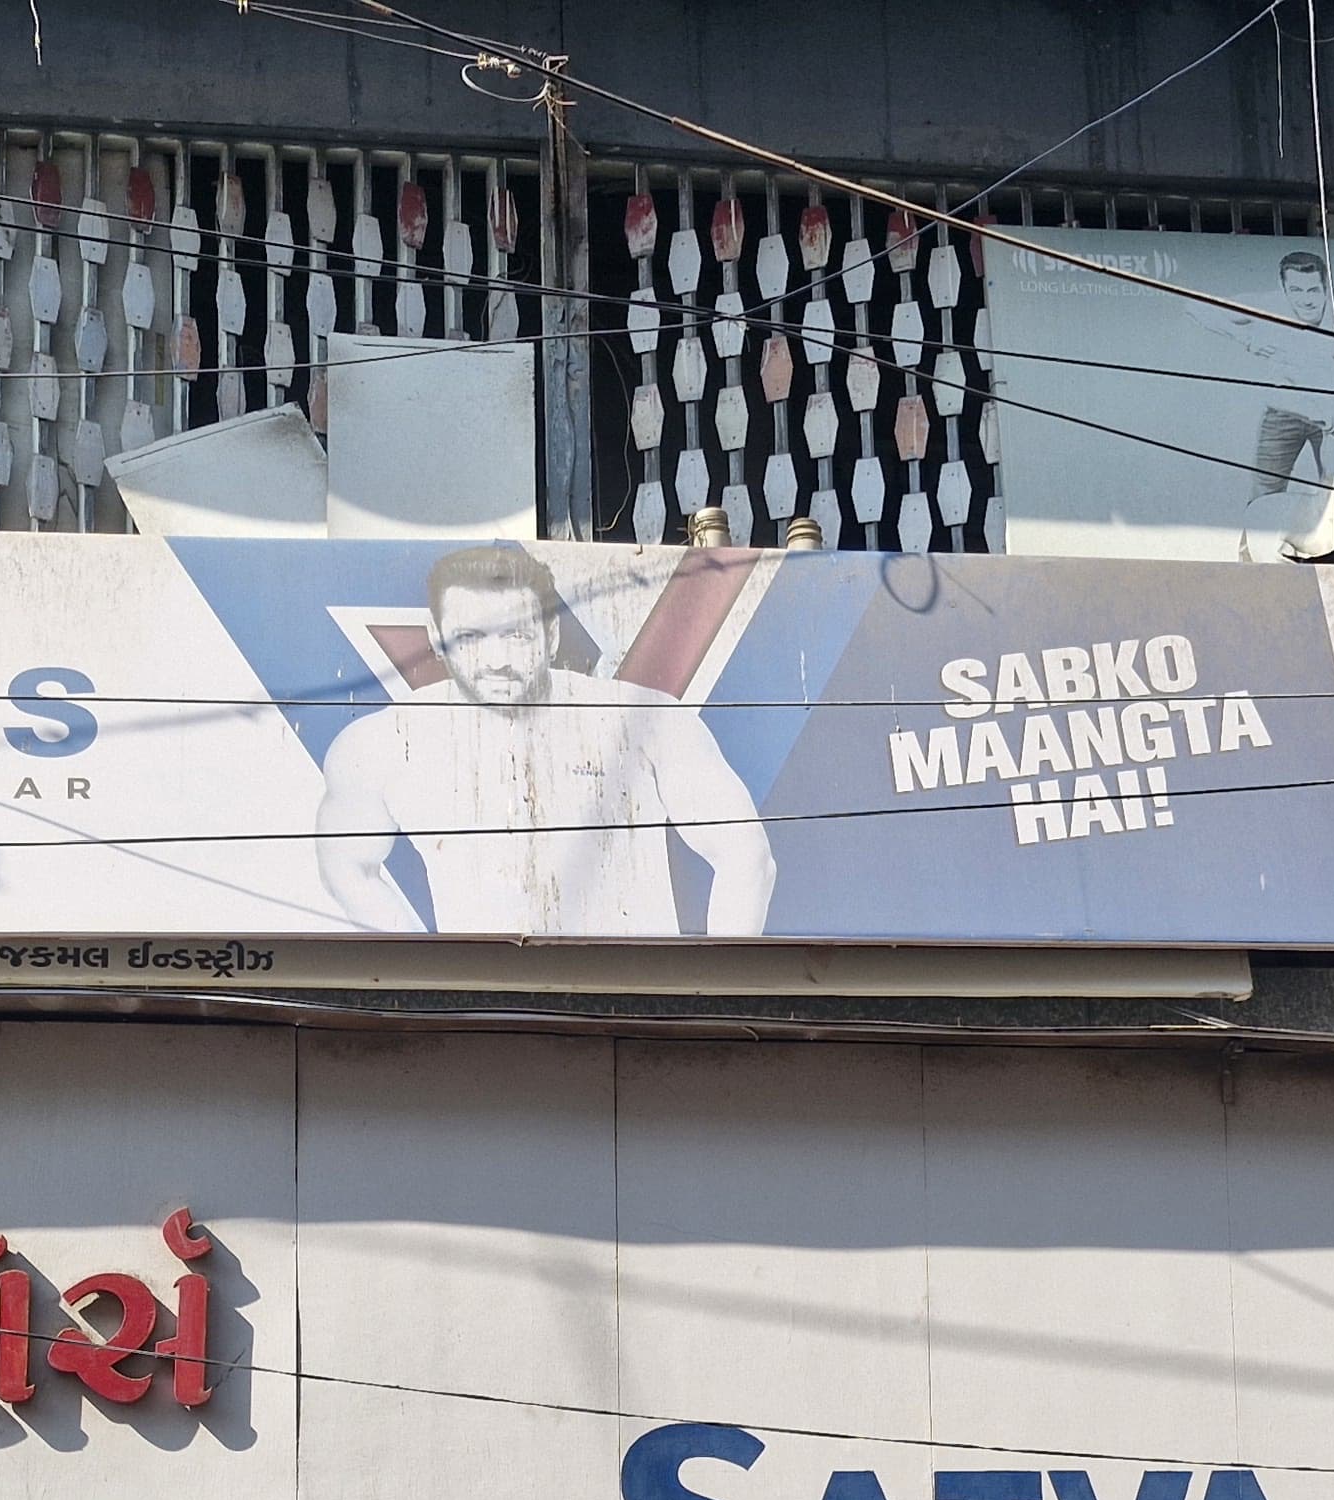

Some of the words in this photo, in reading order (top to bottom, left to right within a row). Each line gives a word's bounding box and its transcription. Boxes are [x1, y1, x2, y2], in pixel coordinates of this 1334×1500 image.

[1019, 281, 1058, 294] LONG
[1061, 282, 1117, 295] LASTING
[1043, 253, 1148, 276] SPANDEX
[941, 633, 1199, 720] SABKO
[890, 690, 1272, 795] MAANGTA
[1013, 769, 1175, 847] HAI!
